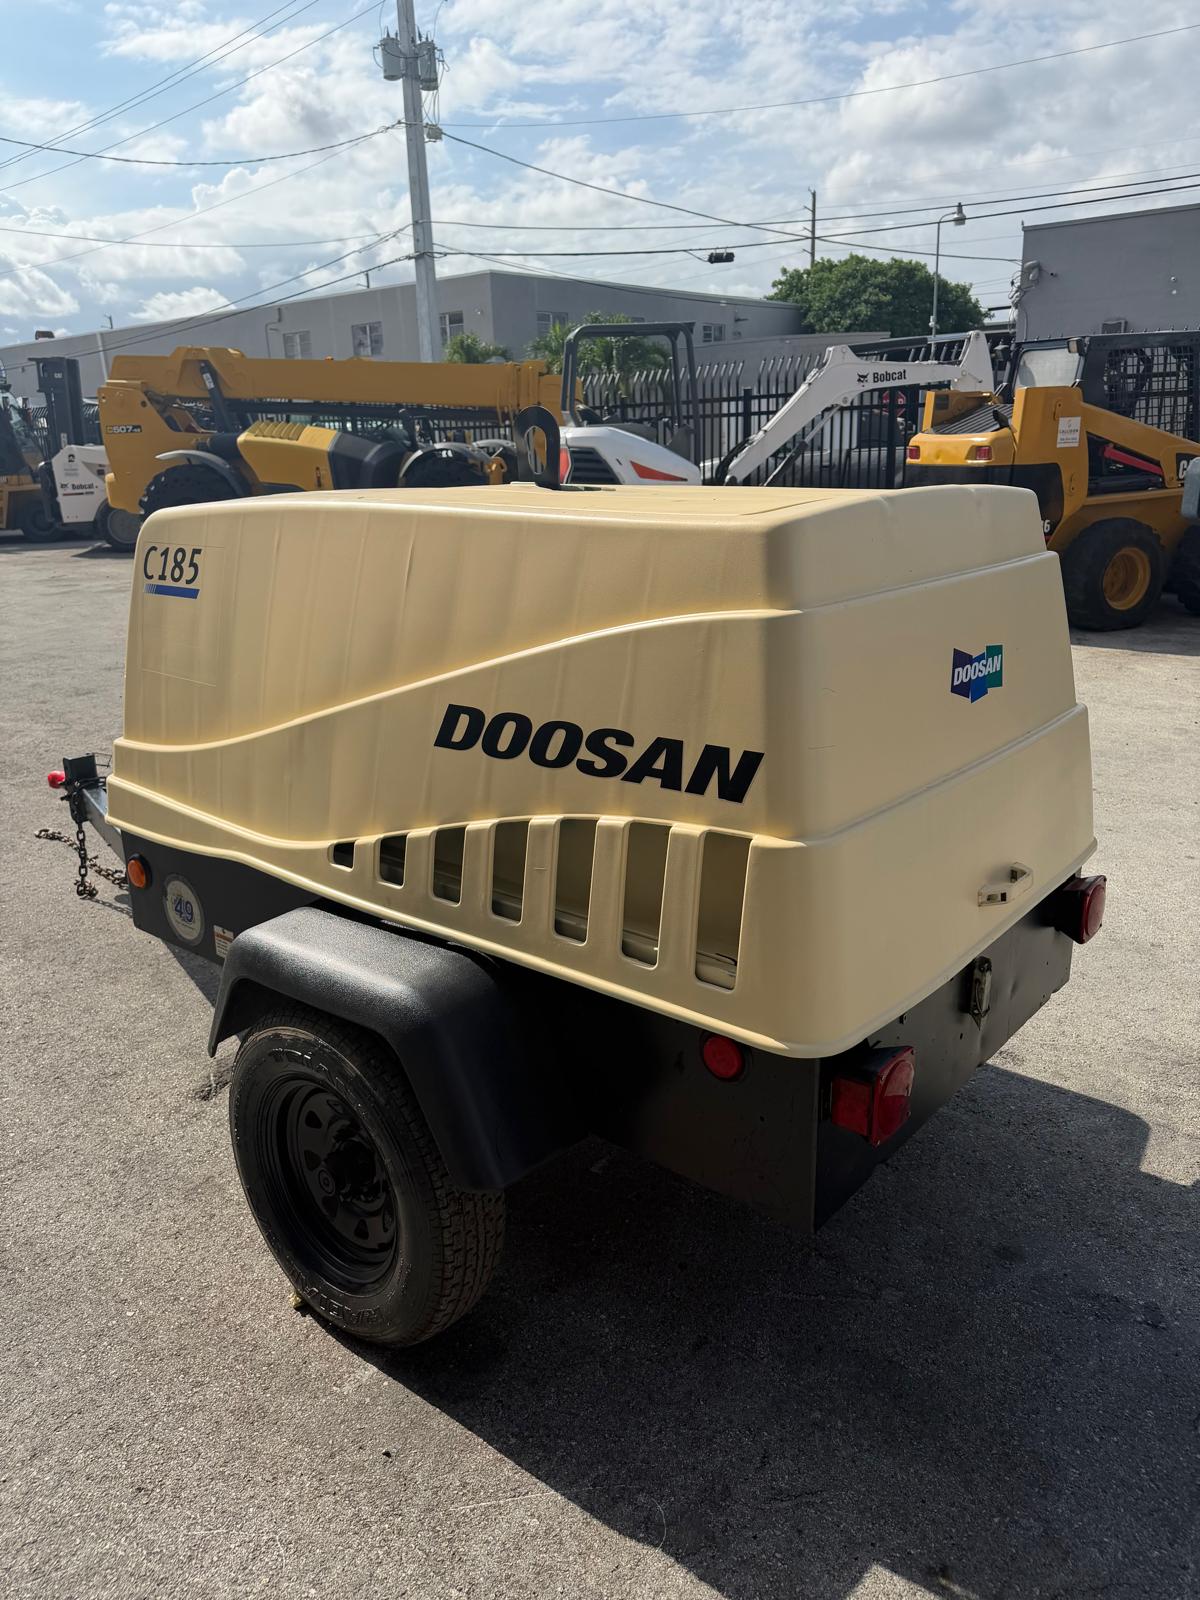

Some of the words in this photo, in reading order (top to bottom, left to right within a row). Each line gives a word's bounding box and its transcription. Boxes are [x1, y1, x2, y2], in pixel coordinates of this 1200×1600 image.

[873, 369, 906, 383] Bobcat
[1040, 519, 1050, 533] 6
[144, 546, 202, 585] C185
[953, 654, 1001, 686] DOOSAN
[433, 703, 765, 803] DOOSAN
